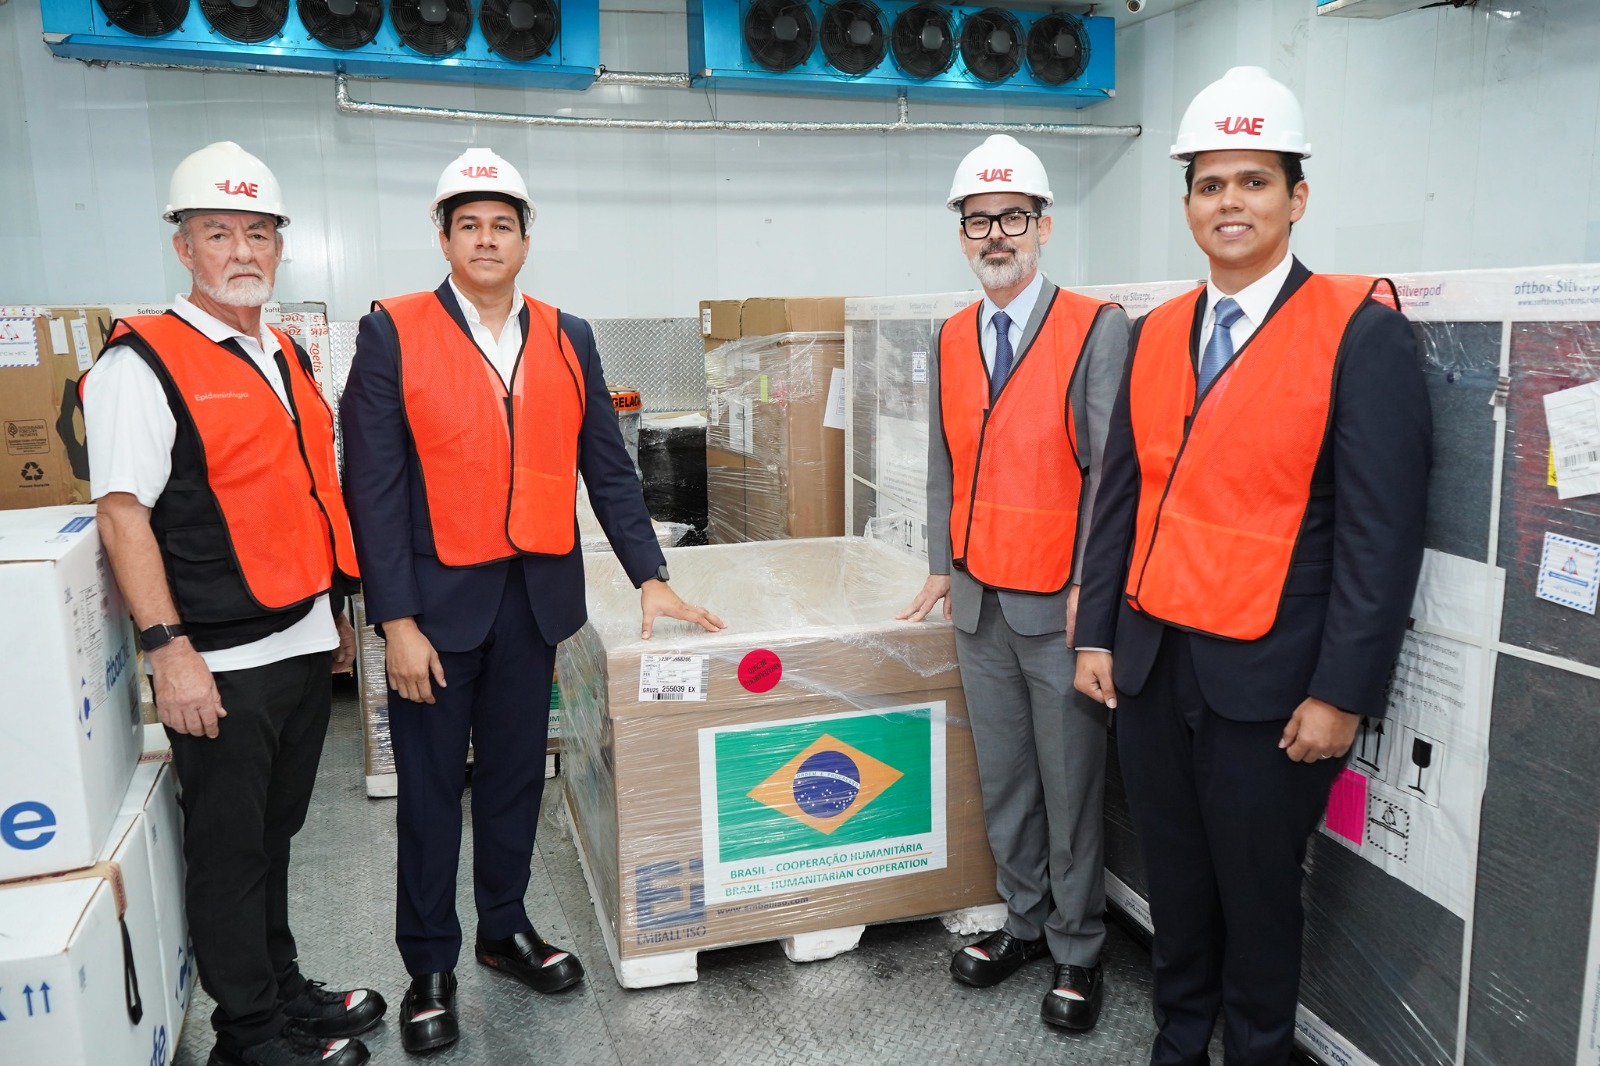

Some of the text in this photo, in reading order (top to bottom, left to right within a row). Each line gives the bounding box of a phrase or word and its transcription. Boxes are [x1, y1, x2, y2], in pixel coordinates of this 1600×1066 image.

[1223, 116, 1264, 136] UAE
[468, 166, 498, 179] UAE
[983, 168, 1013, 182] UAE
[224, 179, 258, 199] UAE
[1397, 284, 1442, 299] Silverpod
[309, 342, 324, 374] zoetis
[730, 865, 767, 880] BRASIL
[776, 853, 848, 872] COOPERAÇÃO
[850, 842, 924, 861] HUMANITÁRIA
[725, 884, 762, 897] BRAZIL
[771, 869, 854, 890] HUMANITARIAN
[856, 857, 929, 877] COOPERATION
